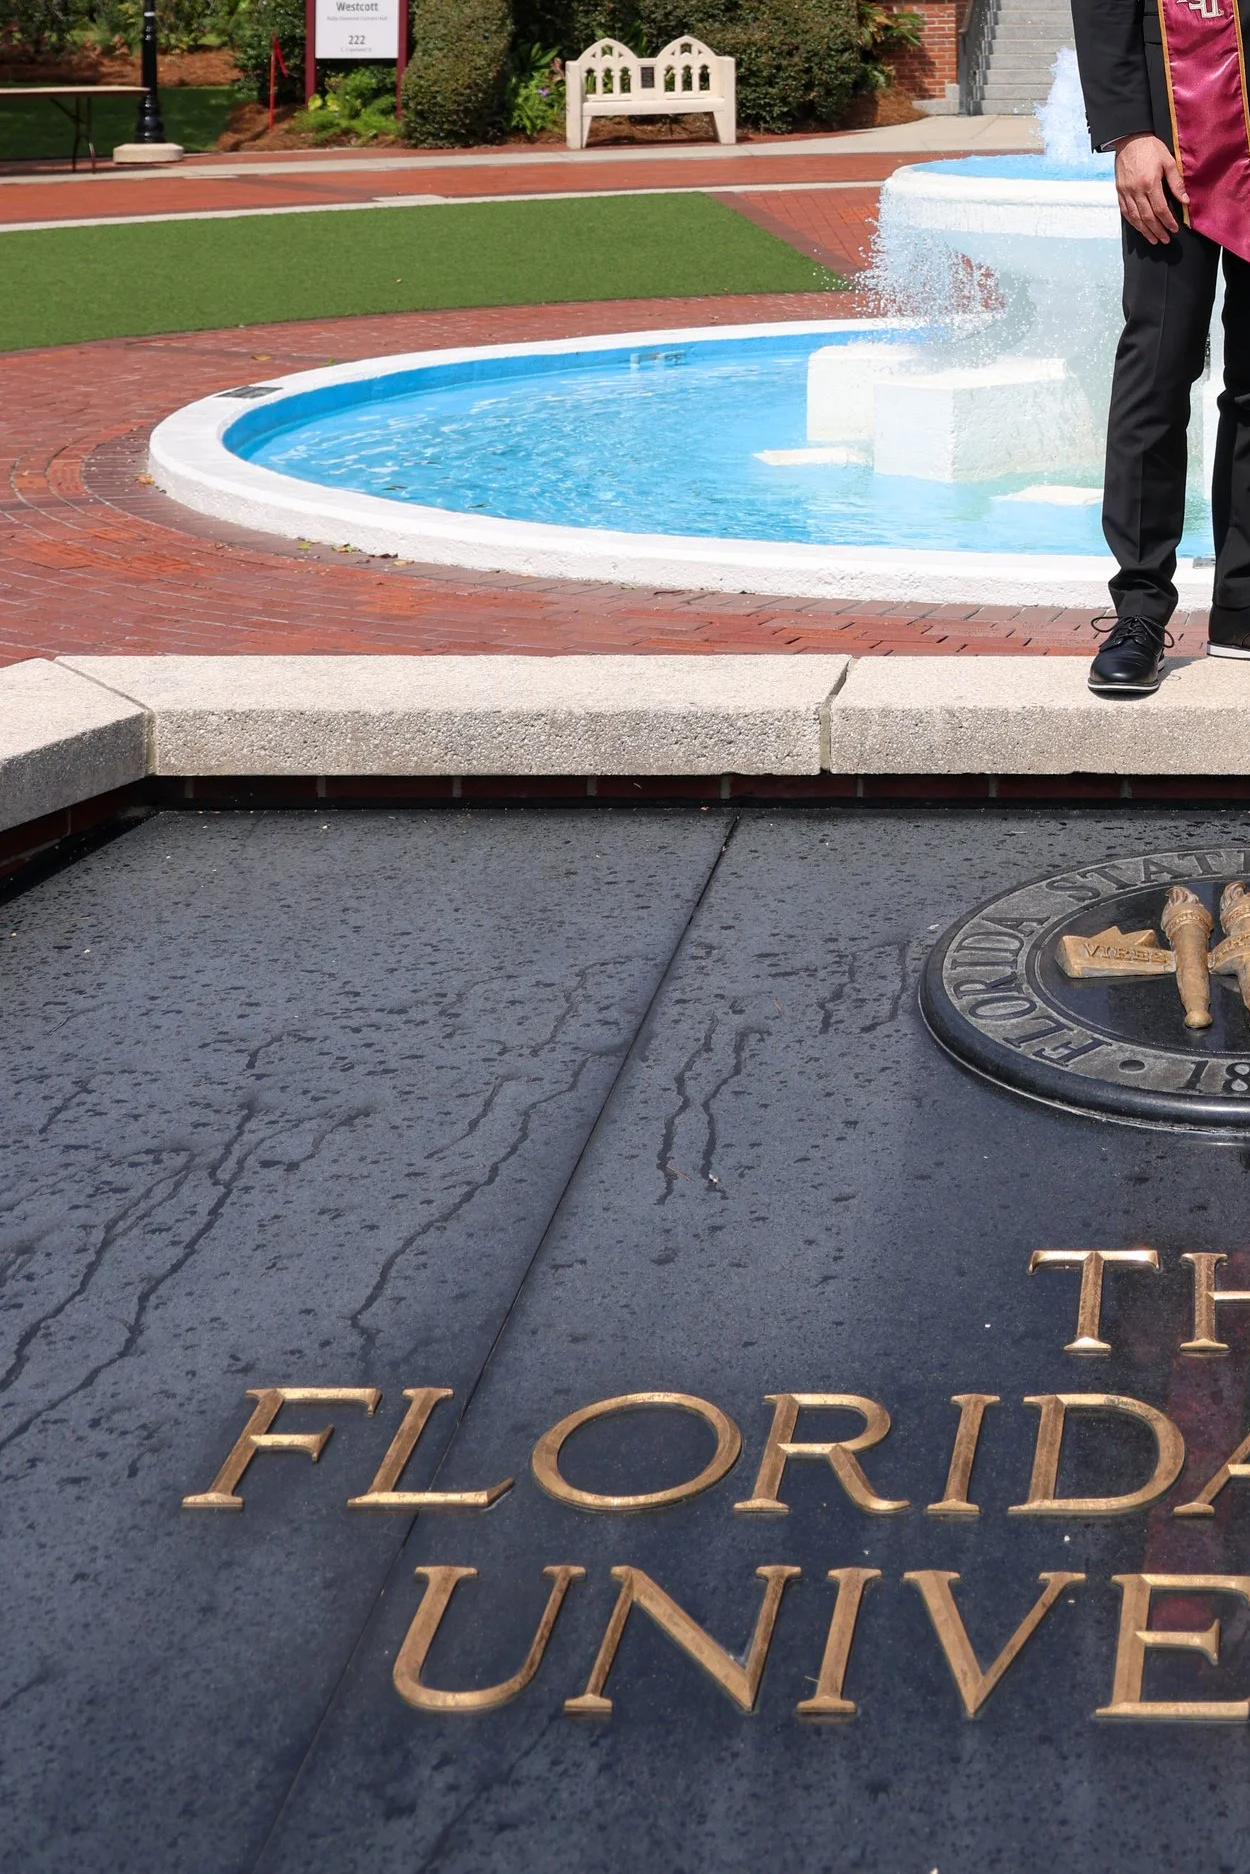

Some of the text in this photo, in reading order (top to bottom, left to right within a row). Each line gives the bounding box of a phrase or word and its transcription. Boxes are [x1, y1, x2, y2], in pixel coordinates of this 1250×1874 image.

[336, 2, 378, 12] Westcott
[348, 35, 365, 45] 222
[1083, 943, 1168, 964] VIRES
[951, 916, 1113, 1067] FLORIDA
